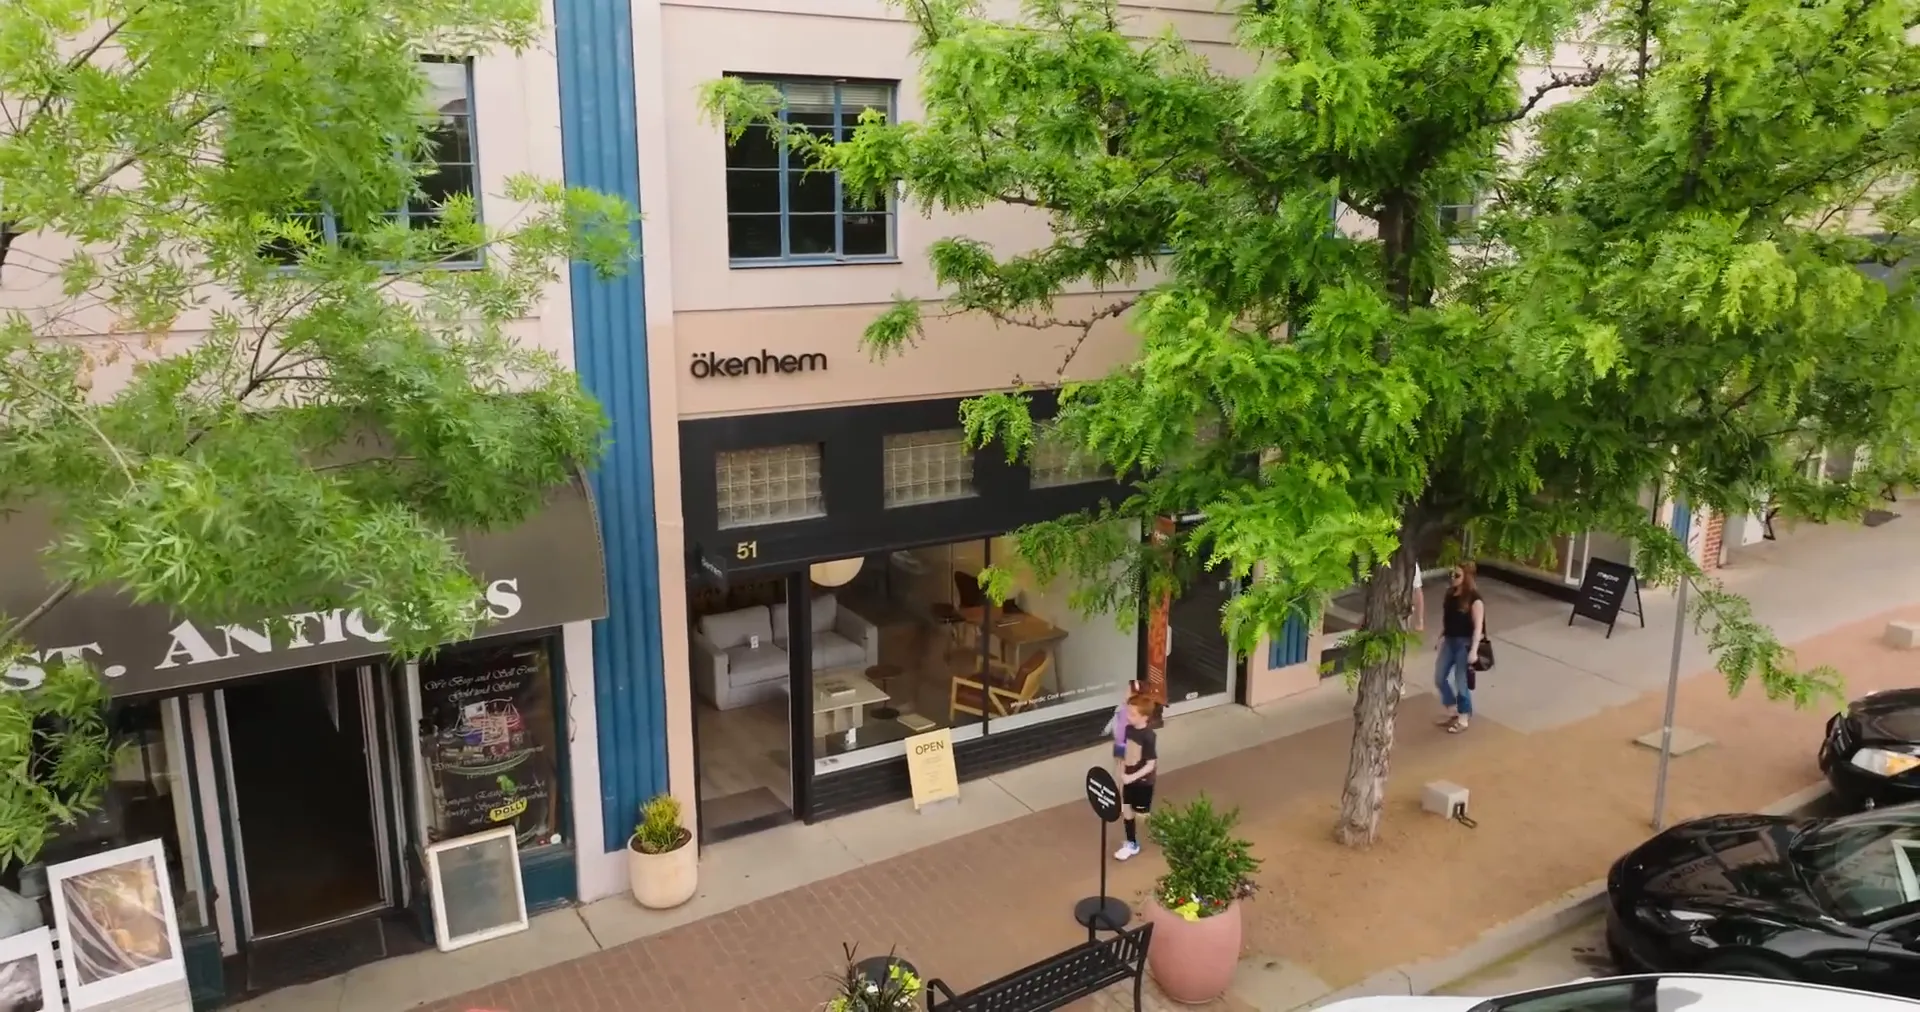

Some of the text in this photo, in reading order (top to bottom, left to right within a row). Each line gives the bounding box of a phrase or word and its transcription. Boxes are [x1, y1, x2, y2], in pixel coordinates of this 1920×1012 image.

[689, 348, 828, 379] ökenhem
[736, 540, 757, 560] 51
[915, 740, 945, 756] OPEN
